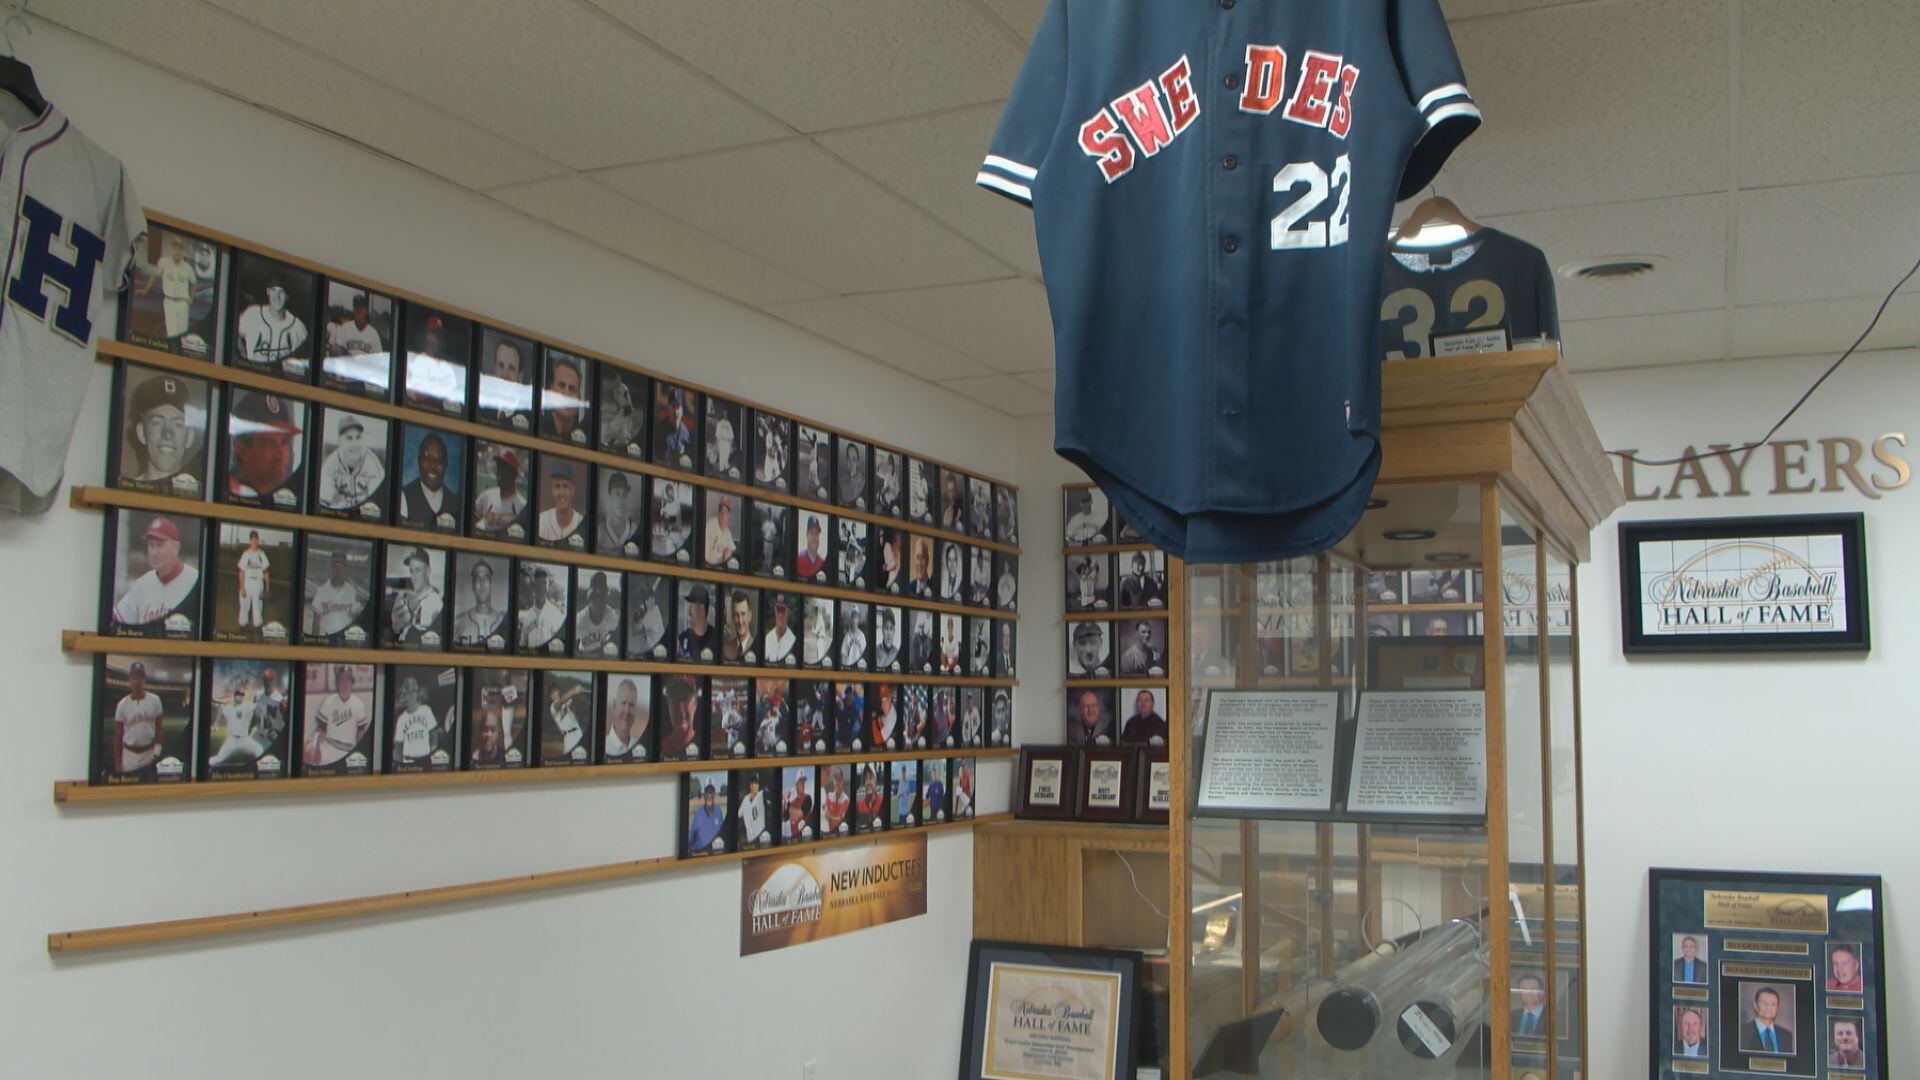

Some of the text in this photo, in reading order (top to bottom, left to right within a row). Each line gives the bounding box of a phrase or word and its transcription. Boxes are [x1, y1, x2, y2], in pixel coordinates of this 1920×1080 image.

[1271, 152, 1350, 250] 22
[6, 194, 106, 348] H
[1380, 280, 1505, 361] 32
[1615, 432, 1911, 502] LAYERS
[1652, 574, 1834, 604] Nebraska Baseball
[1664, 604, 1831, 626] HALL of FAME
[830, 856, 921, 893] NEW INDUCTEES
[752, 912, 780, 934] HALL
[791, 906, 821, 924] FAME
[1014, 1016, 1046, 1029] HALL
[1058, 1020, 1091, 1035] FAME
